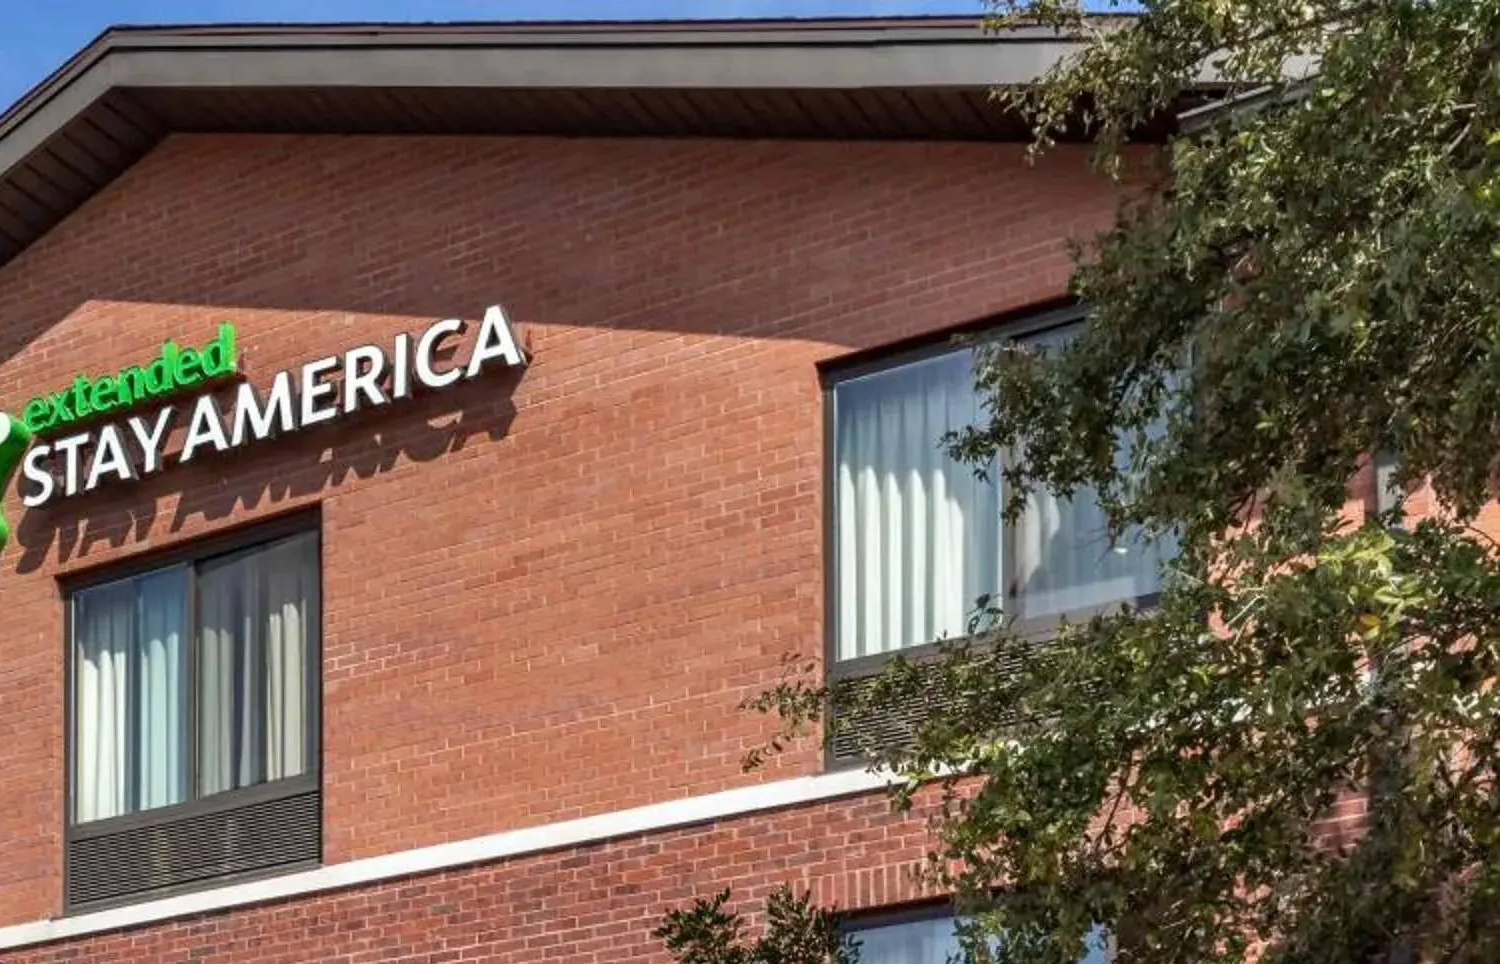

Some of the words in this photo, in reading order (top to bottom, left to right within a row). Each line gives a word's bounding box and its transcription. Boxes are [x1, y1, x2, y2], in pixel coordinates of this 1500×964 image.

[22, 320, 238, 432] extended
[22, 405, 174, 508] STAY
[179, 304, 522, 463] AMERICA
